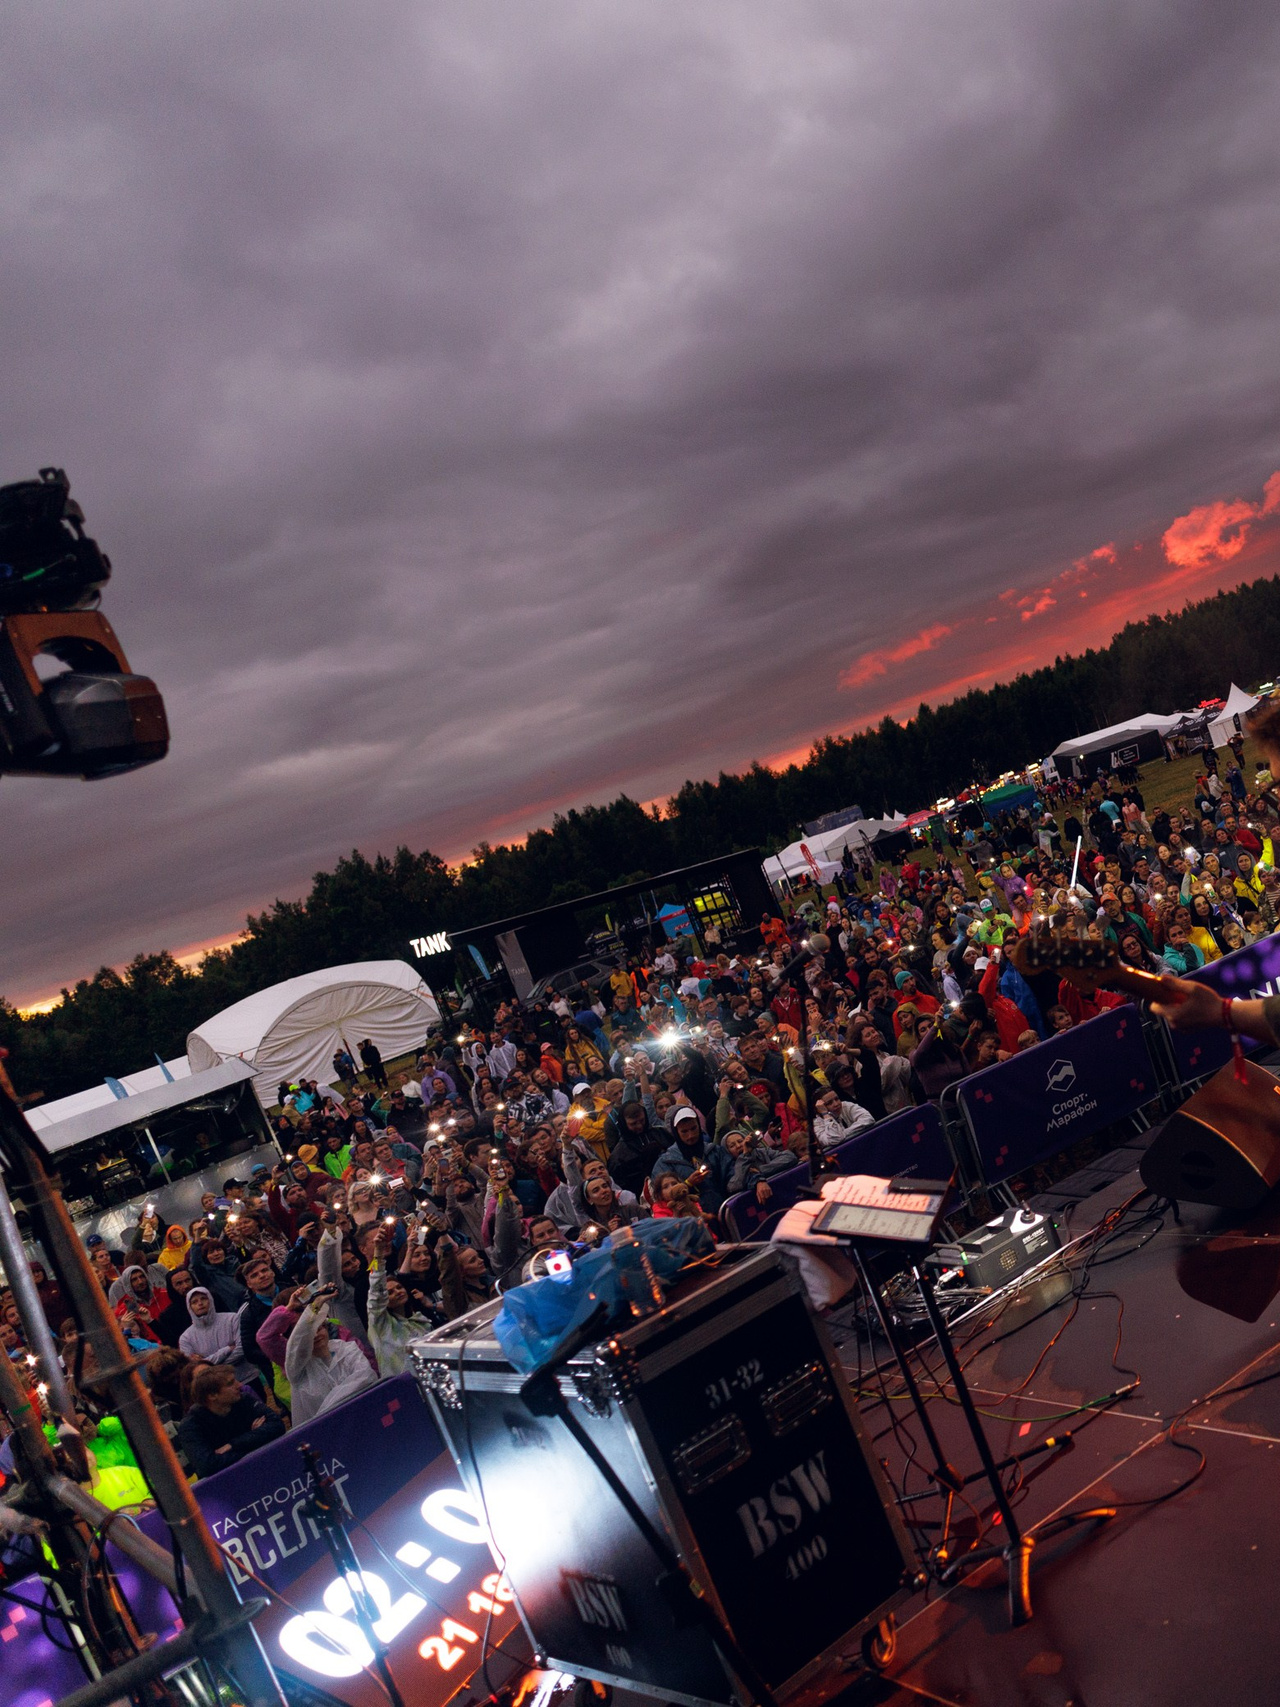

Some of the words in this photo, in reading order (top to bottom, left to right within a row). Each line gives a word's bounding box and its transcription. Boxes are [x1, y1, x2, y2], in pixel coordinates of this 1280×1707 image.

[409, 931, 451, 958] TANK
[1046, 1100, 1098, 1132] Марафон
[705, 1358, 764, 1410] 31-32
[211, 1458, 346, 1539] ГАСТРОДАЧА
[736, 1450, 832, 1560] BSW
[784, 1534, 828, 1582] 400
[418, 1617, 480, 1671] 21
